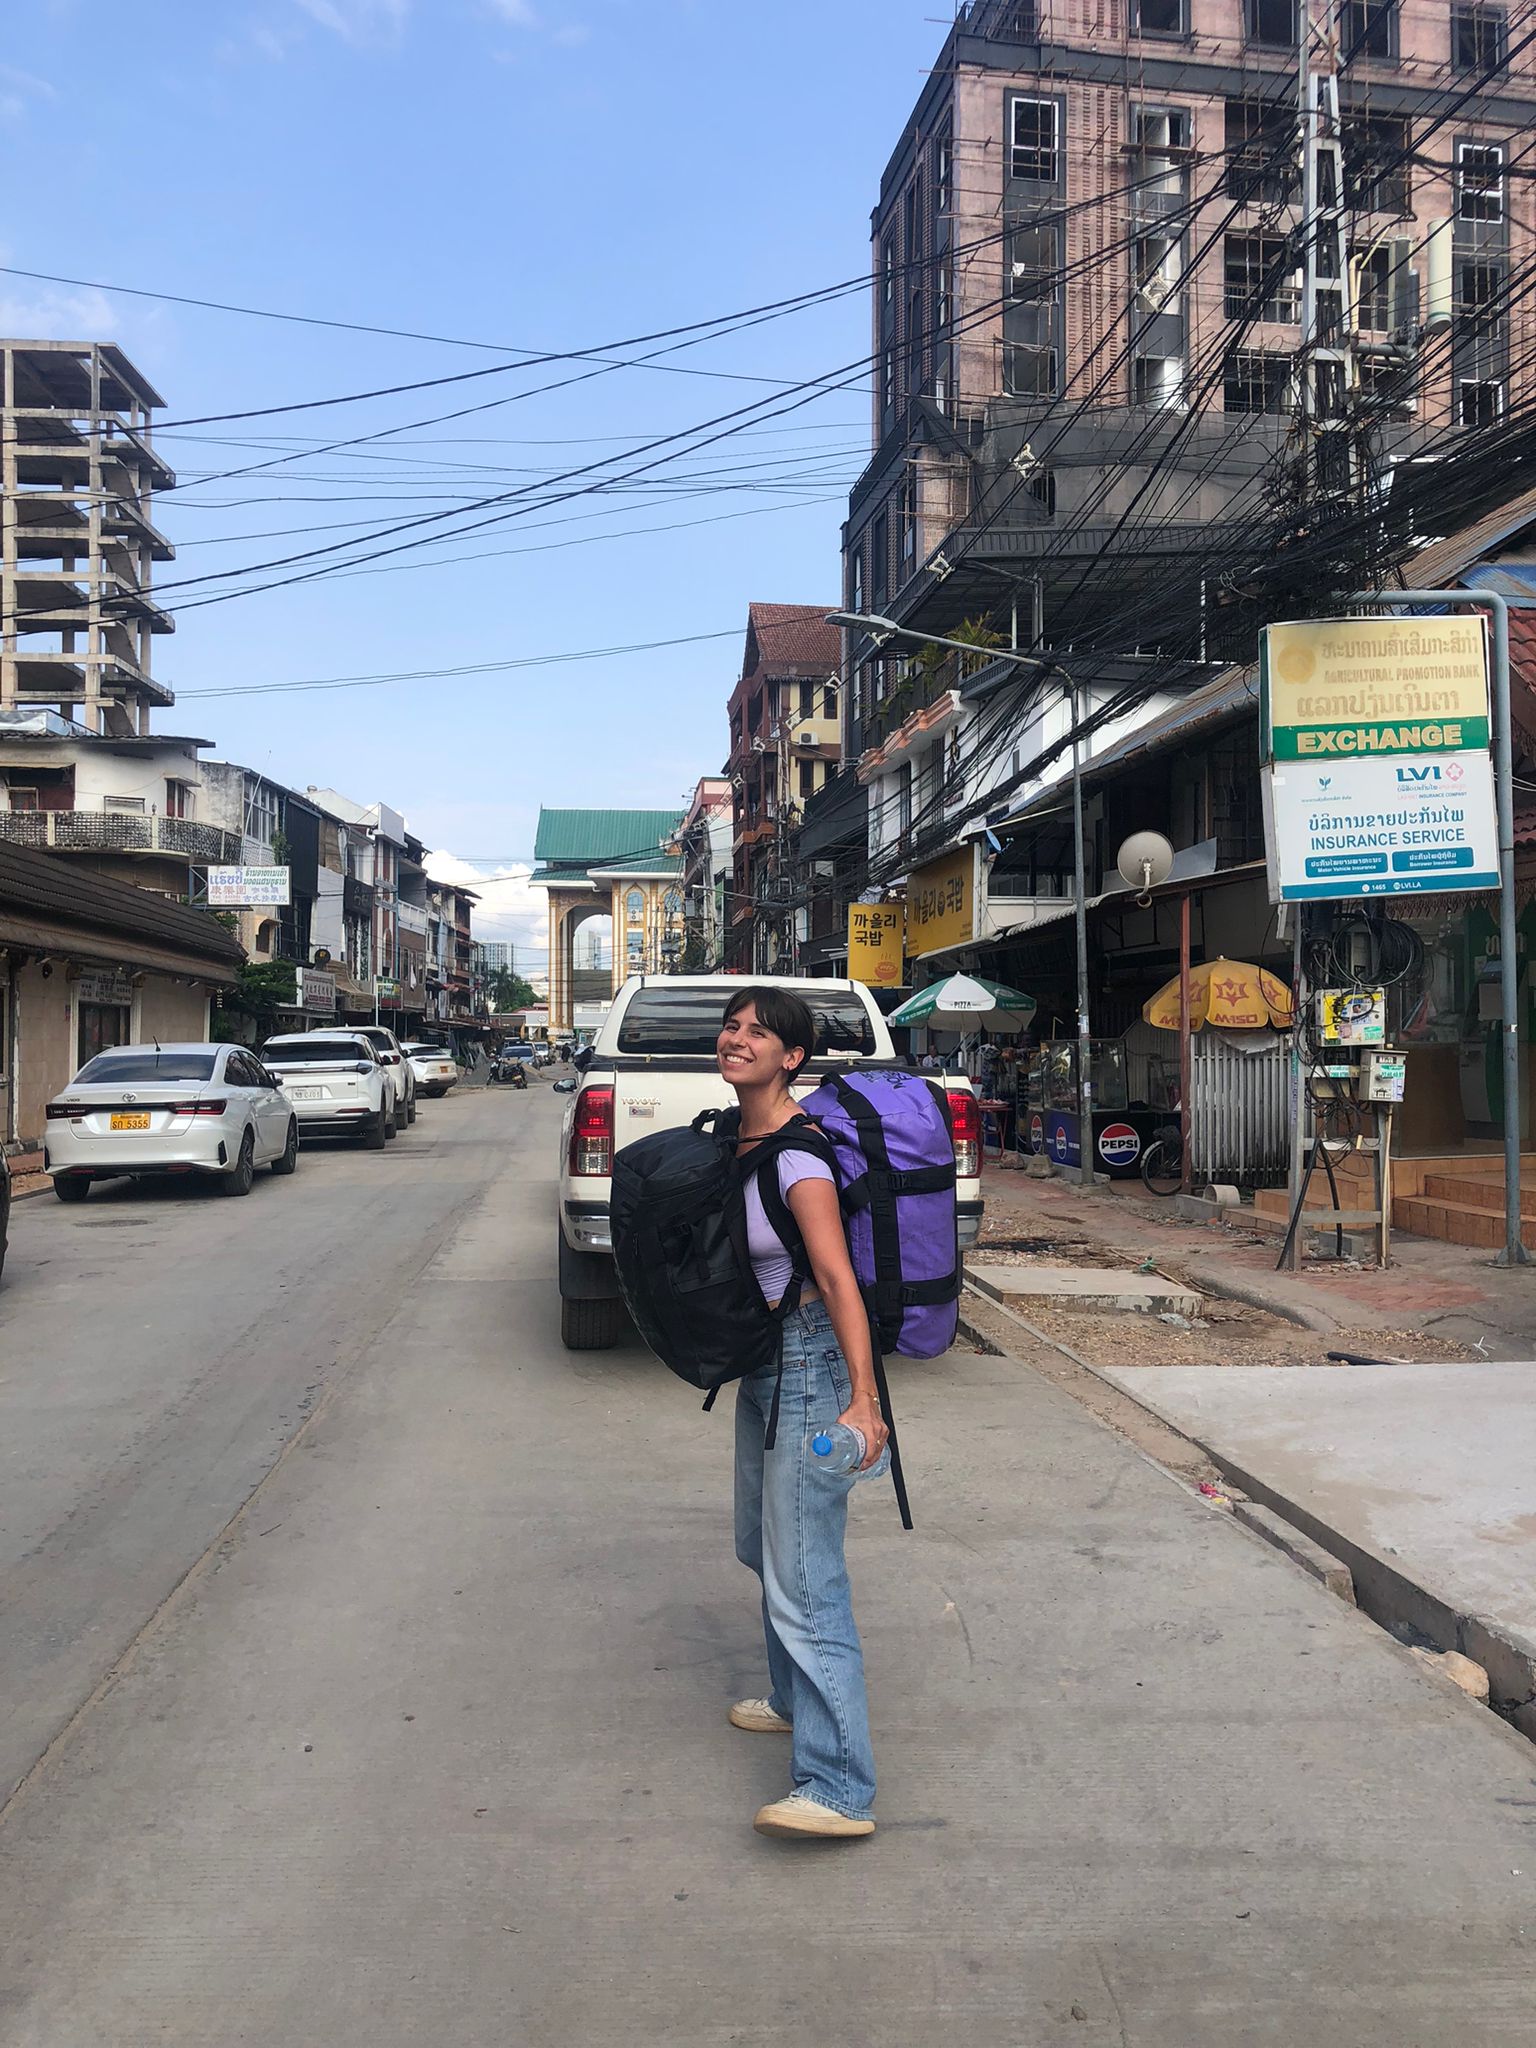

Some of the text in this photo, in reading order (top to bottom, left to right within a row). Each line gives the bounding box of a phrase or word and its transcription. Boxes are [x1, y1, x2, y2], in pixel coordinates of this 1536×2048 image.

[1324, 664, 1480, 684] AGRICULTURAL PROMOTION BANK
[1297, 724, 1463, 754] EXCHANGE
[1396, 766, 1442, 782] LVI
[1311, 828, 1465, 851] INSURANCE SERVICE
[946, 875, 965, 914] 국밥
[853, 913, 897, 928] 까올리
[854, 930, 884, 947] 국밥
[953, 1001, 972, 1009] PIZZA
[621, 1097, 662, 1106] TOYOTA
[127, 1119, 148, 1129] 5355
[1101, 1139, 1138, 1149] PEPSI
